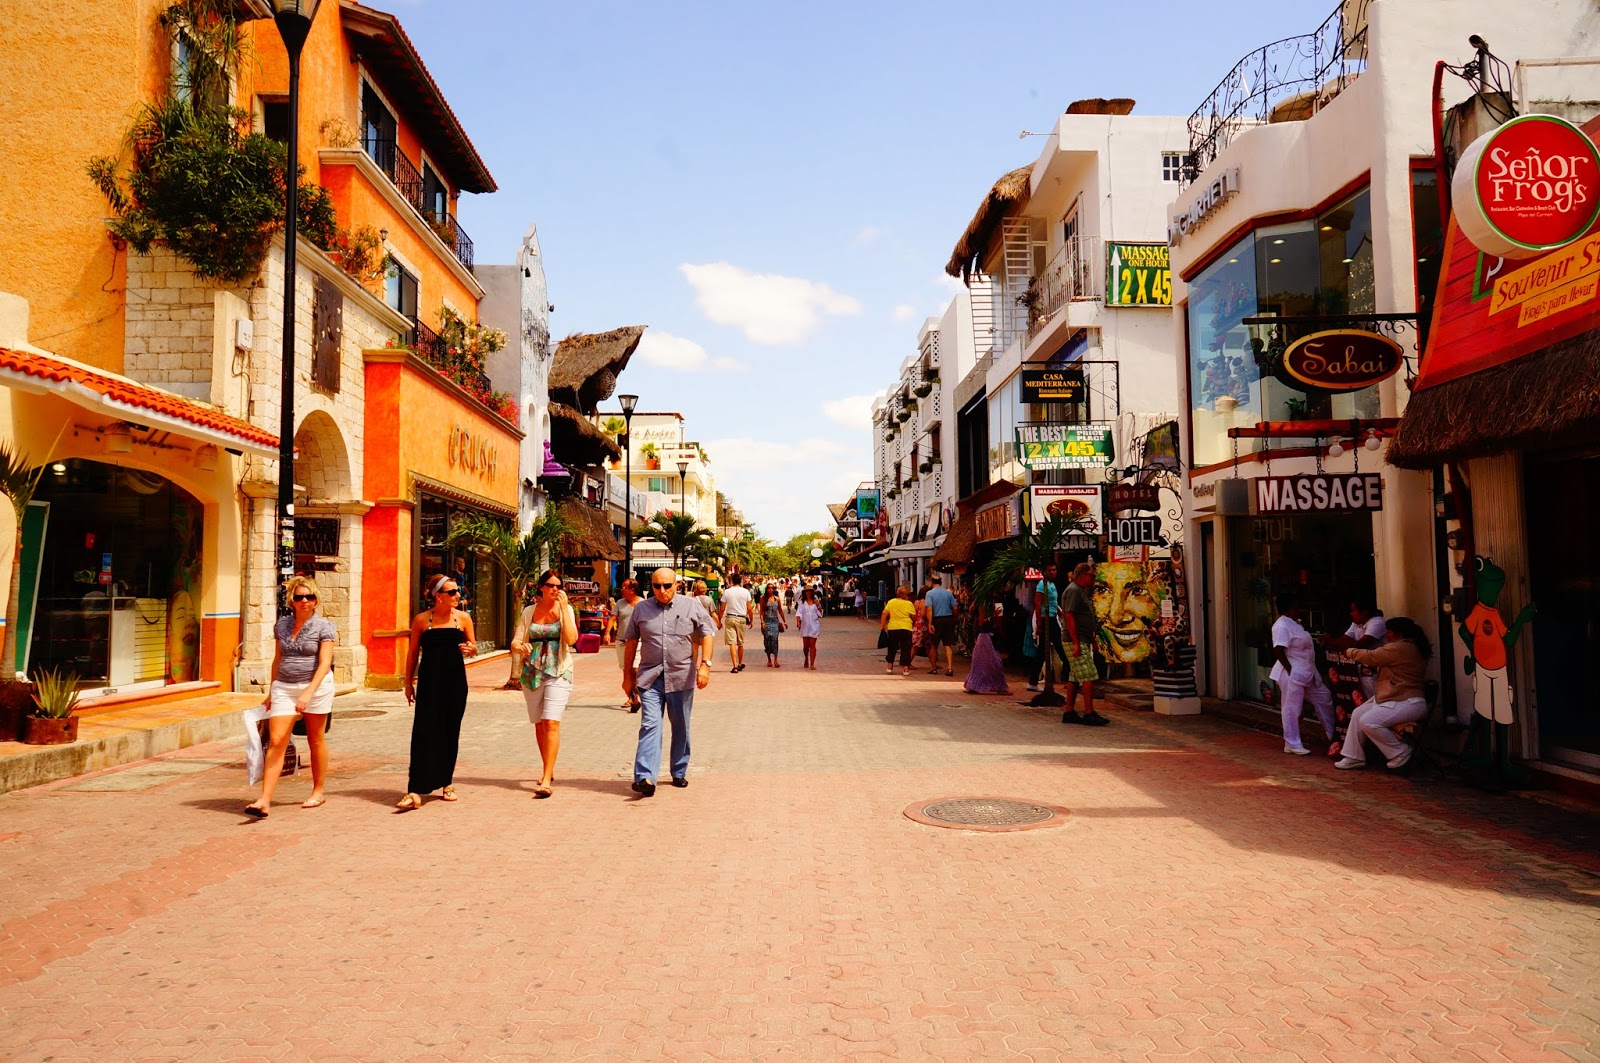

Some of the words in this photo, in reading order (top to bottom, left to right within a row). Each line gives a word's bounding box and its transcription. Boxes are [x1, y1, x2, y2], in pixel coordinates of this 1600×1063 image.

[1488, 147, 1589, 180] Señor
[1492, 179, 1588, 213] Frog's
[1120, 245, 1170, 261] MASSAG
[1128, 259, 1144, 267] ONE
[1145, 259, 1168, 268] HOUR
[1121, 268, 1132, 304] 2
[1152, 269, 1172, 305] 45
[1497, 256, 1575, 309] Souvenir
[1302, 342, 1387, 375] Sabai
[1025, 380, 1081, 388] MEDITERRANEA
[1043, 373, 1064, 381] CASA
[1018, 427, 1038, 442] THE
[1041, 426, 1066, 441] BEST
[1027, 442, 1043, 458] 2
[1065, 441, 1094, 456] 45
[1032, 463, 1058, 471] BODY
[1059, 462, 1080, 470] AND
[1115, 488, 1152, 499] HOTEL
[1258, 476, 1381, 512] MASSAGE
[1108, 519, 1160, 543] HOTEL
